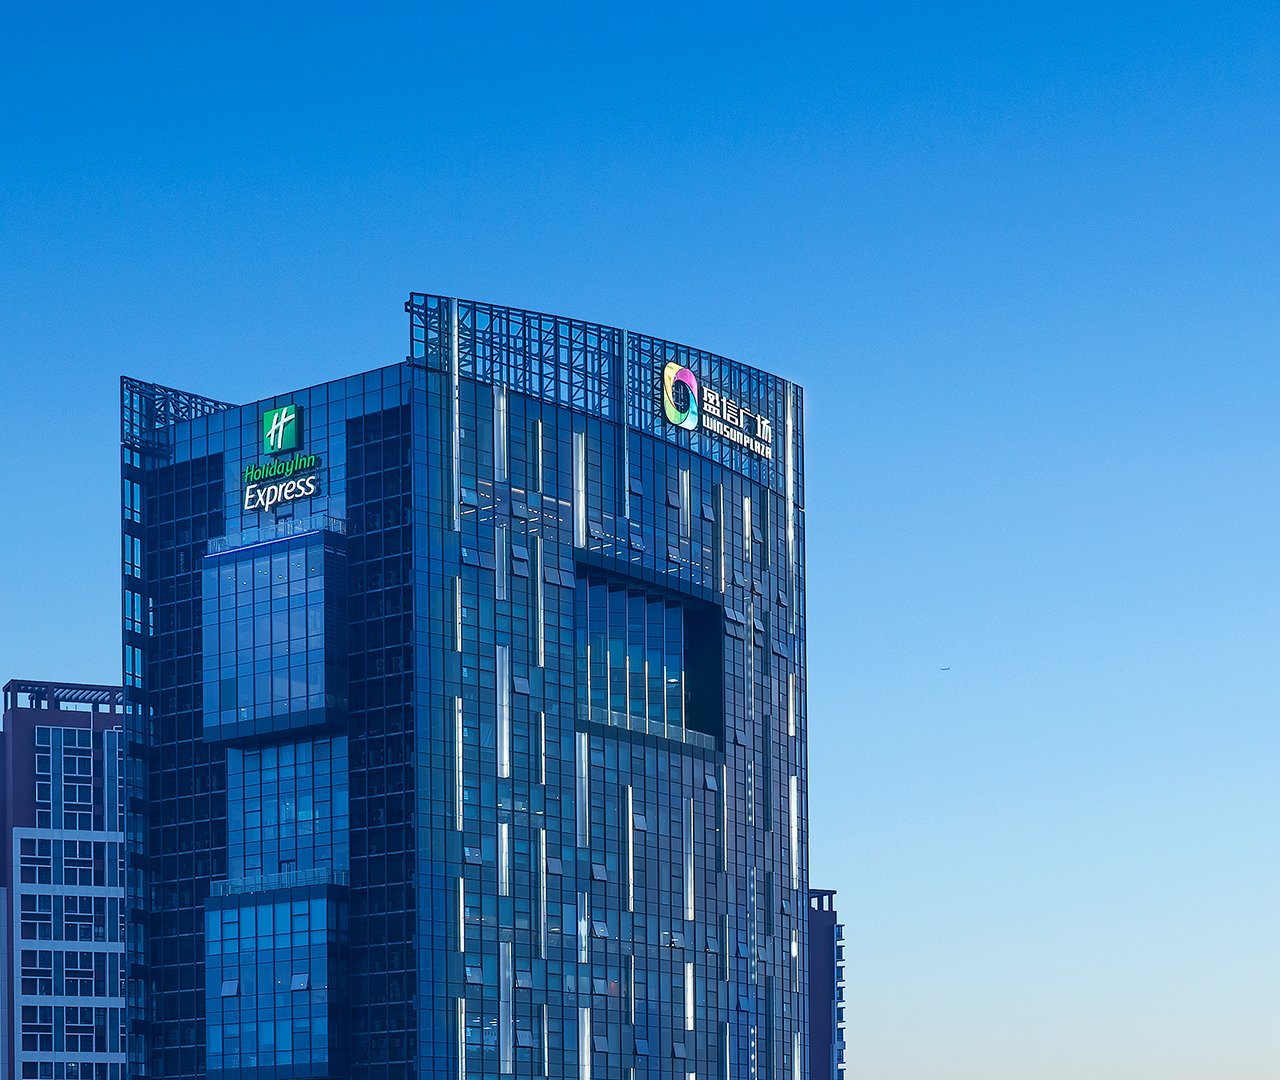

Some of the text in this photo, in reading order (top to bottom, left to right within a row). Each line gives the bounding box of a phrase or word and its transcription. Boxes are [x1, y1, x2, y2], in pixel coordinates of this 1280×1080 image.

[703, 386, 772, 443] 盈信广场
[744, 436, 772, 459] PLAZA
[244, 475, 317, 512] Express
